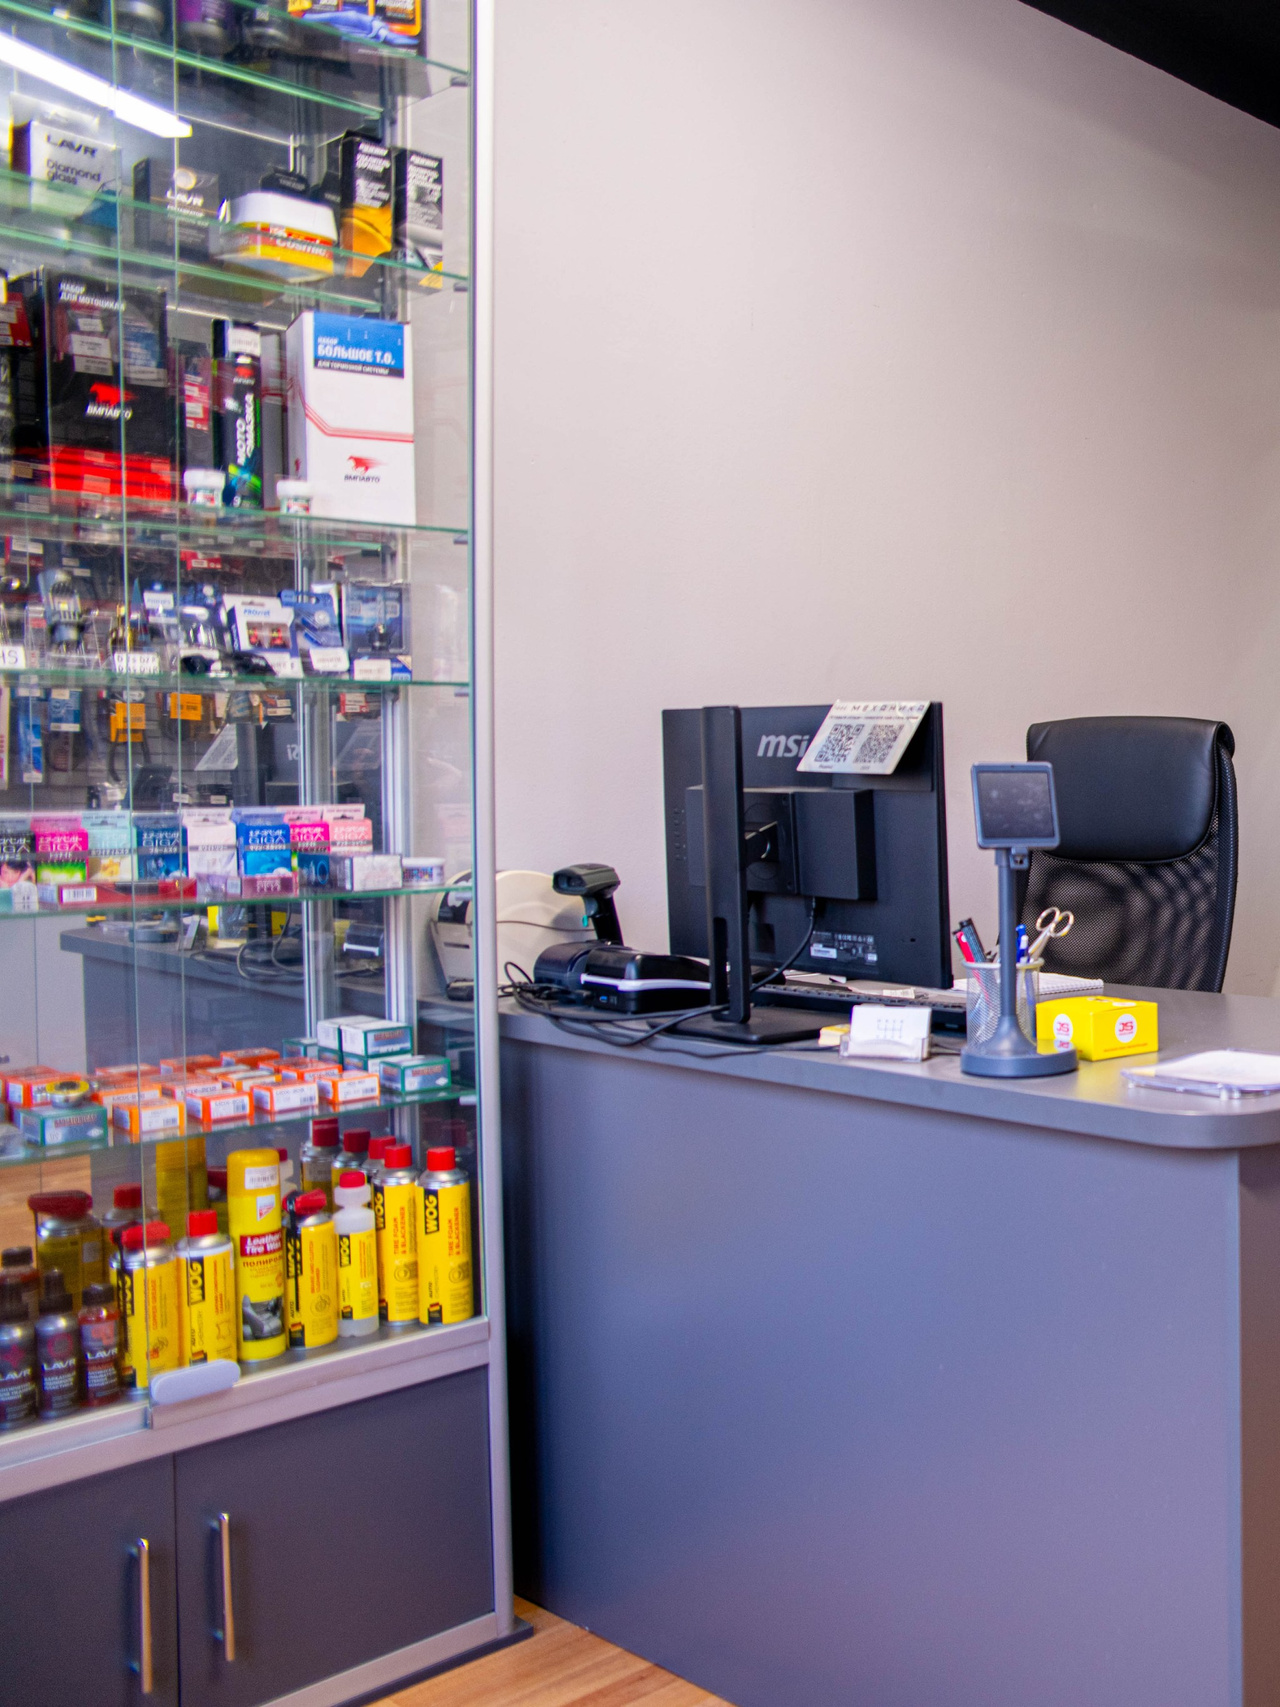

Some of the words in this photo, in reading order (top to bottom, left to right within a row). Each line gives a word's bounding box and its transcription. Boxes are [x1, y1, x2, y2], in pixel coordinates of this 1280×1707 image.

[46, 134, 98, 156] LAVR
[47, 160, 101, 181] Diamond
[47, 171, 78, 185] glass
[318, 345, 373, 362] БОЛЬШОЕ
[344, 474, 380, 482] ВМПАВТО
[757, 735, 810, 757] msi
[1119, 1022, 1133, 1033] JS
[426, 1195, 437, 1233] WOG
[340, 1237, 349, 1265] WOG
[86, 1349, 118, 1359] LAVR
[42, 1358, 76, 1370] LAVR
